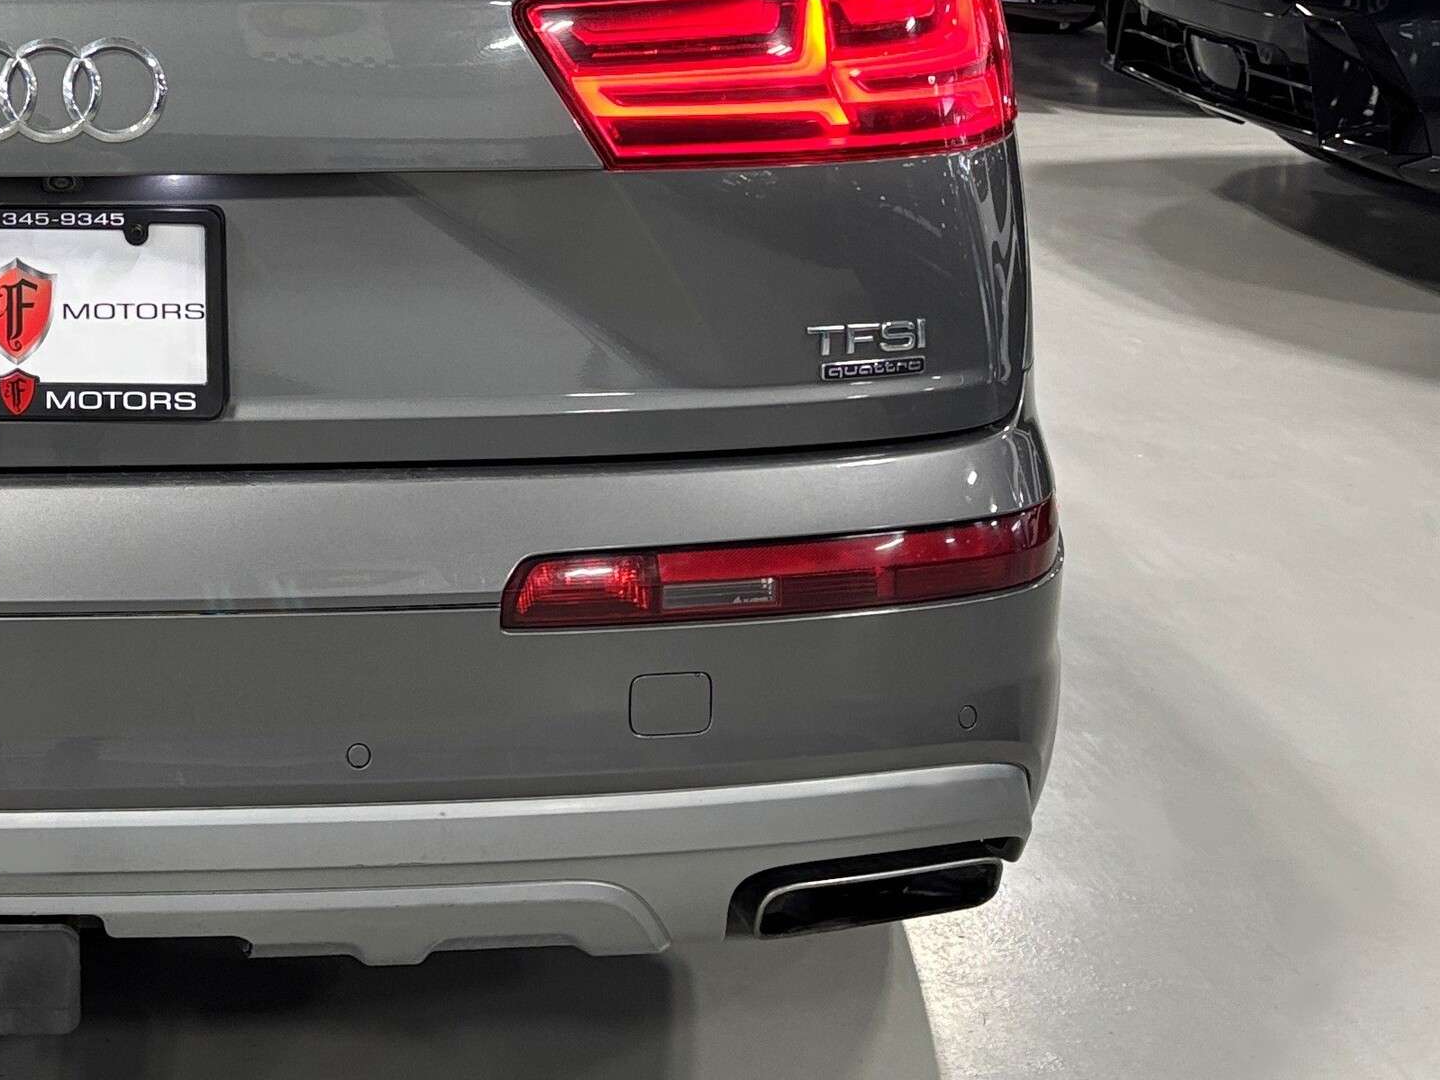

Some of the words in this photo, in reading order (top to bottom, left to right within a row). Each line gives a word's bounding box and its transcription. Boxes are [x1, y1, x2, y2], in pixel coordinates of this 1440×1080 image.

[62, 302, 205, 320] MOTORS
[807, 318, 927, 356] TFSI
[828, 359, 921, 379] quattro
[46, 390, 197, 411] MOTORS
